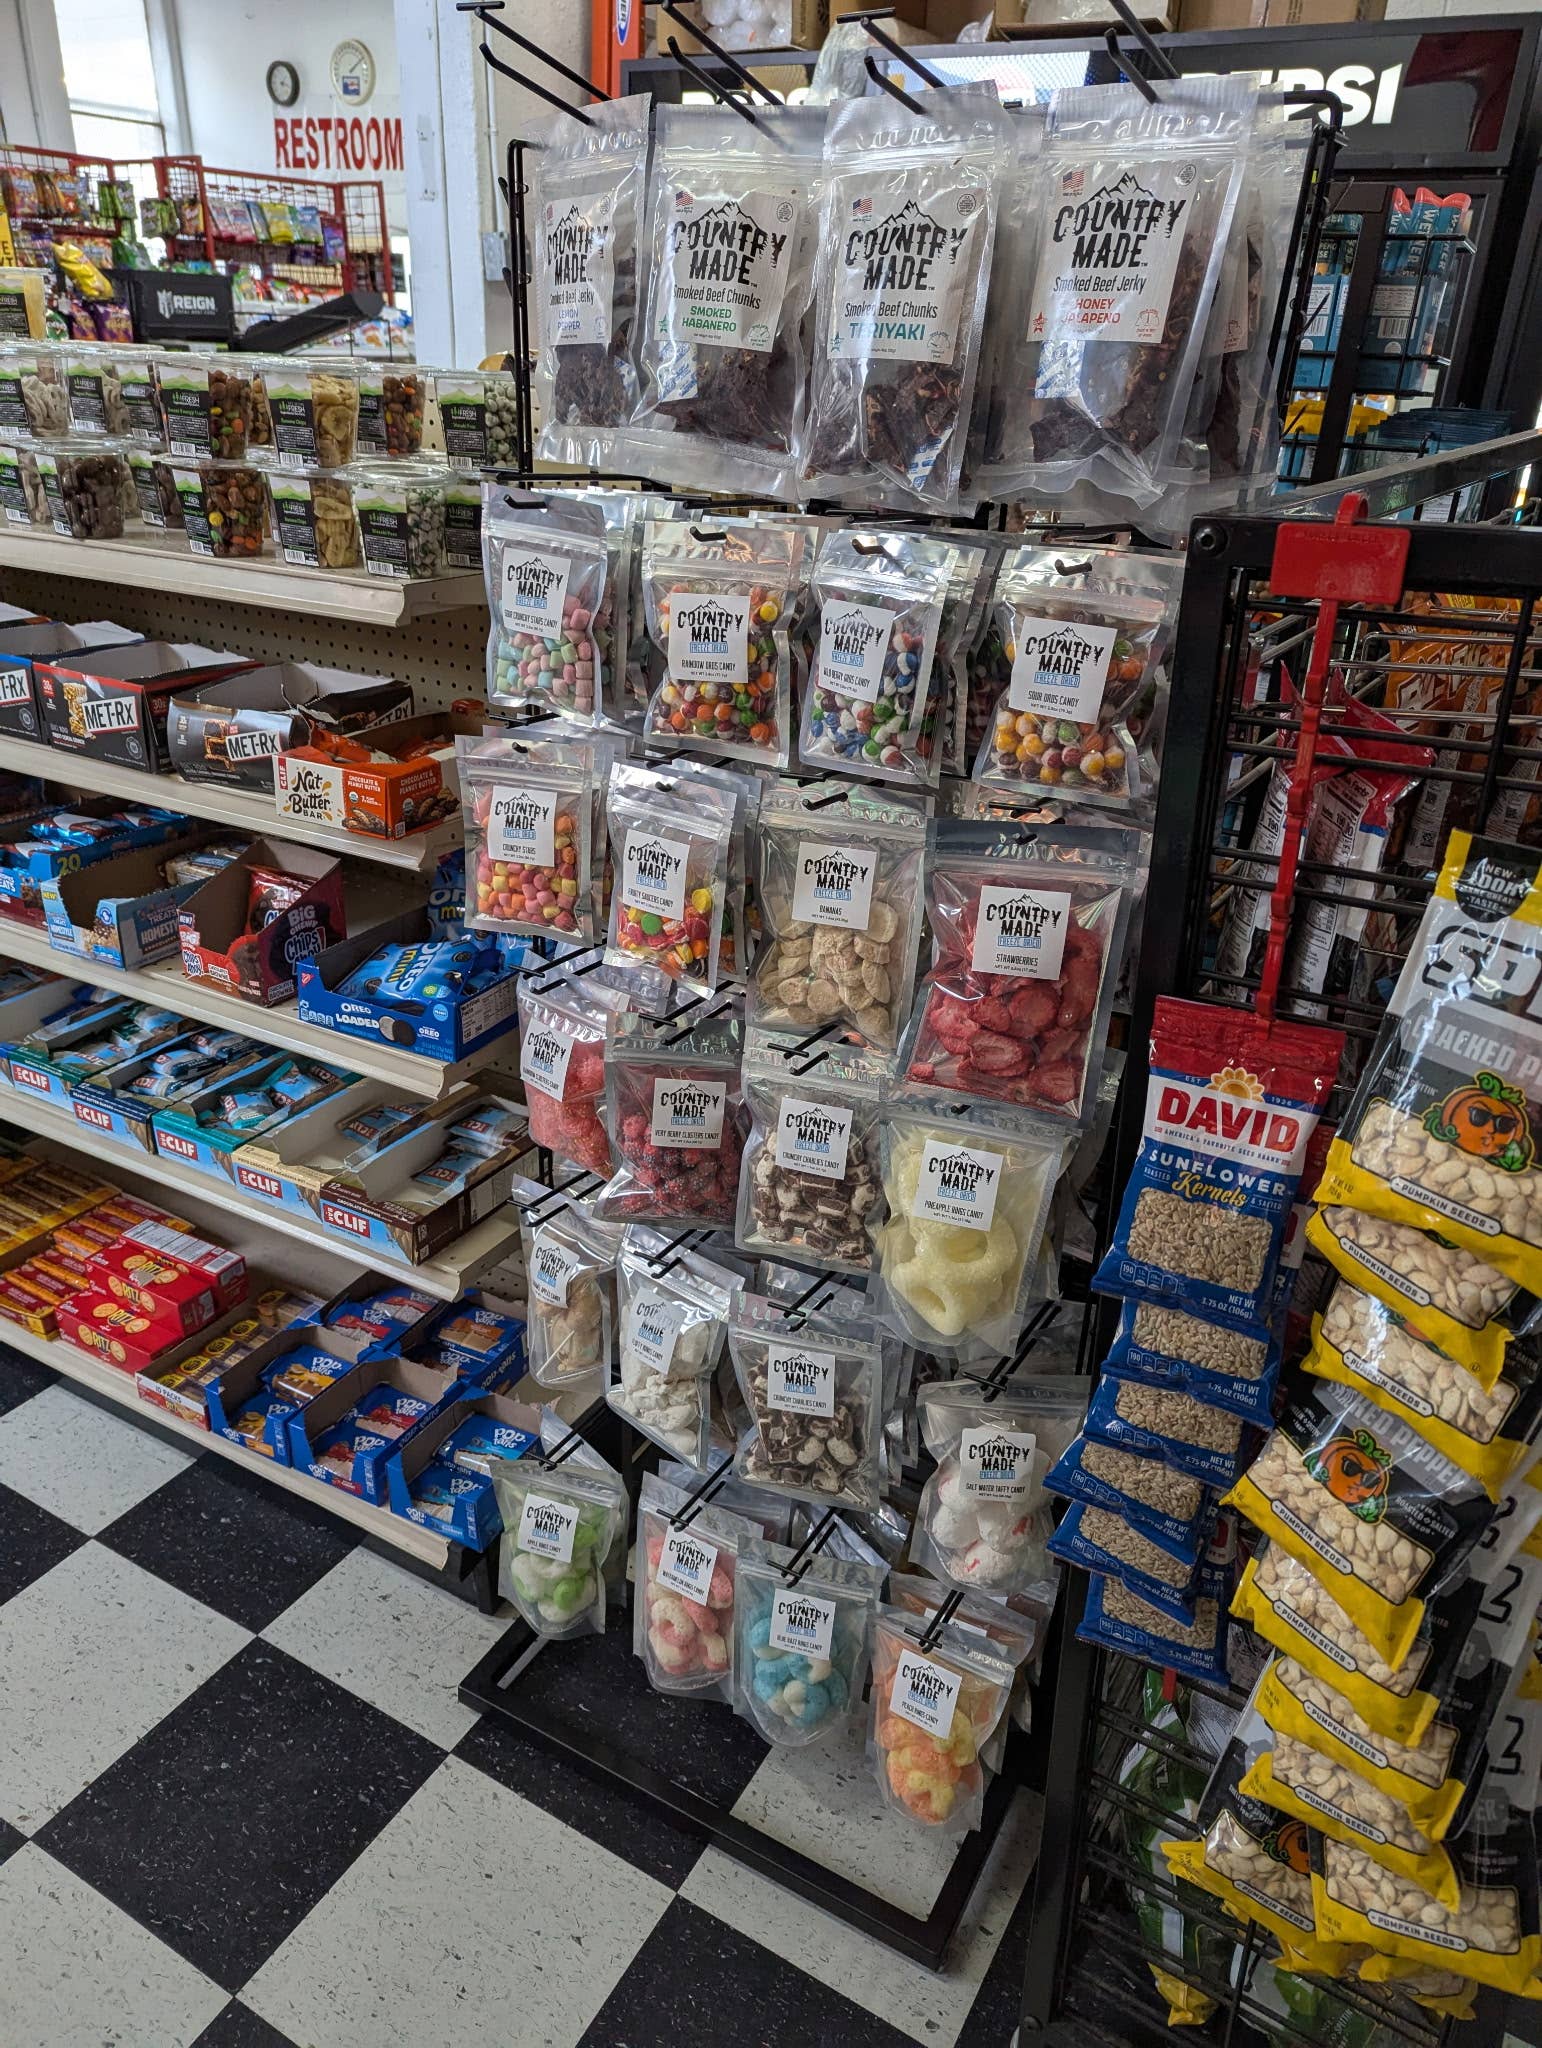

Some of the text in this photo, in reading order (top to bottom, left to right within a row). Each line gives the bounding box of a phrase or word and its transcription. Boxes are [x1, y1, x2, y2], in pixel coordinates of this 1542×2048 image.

[1181, 63, 1403, 127] PSI
[275, 117, 404, 171] RESTROOM
[1053, 200, 1186, 242] COUNTRY
[672, 220, 787, 268] COUNTRY
[845, 223, 968, 265] COUNTRY
[1072, 233, 1146, 268] MADE
[555, 255, 587, 285] MADE
[689, 250, 754, 285] MADE
[864, 255, 932, 290] MADE
[1054, 274, 1146, 294] Smoked Beef Jerky
[174, 295, 215, 310] REIGN
[674, 285, 761, 309] Smoked Beef Chunks
[1075, 299, 1114, 310] HONEY
[559, 308, 578, 318] LEMON
[690, 306, 731, 318] SMOKED
[878, 301, 900, 316] Beef
[902, 302, 938, 318] Chunks
[682, 318, 736, 332] HABANERO
[508, 565, 563, 590] COUNTRY
[518, 581, 549, 600] MADE
[678, 611, 743, 632] COUNTRY
[825, 617, 884, 646] COUNTRY
[692, 626, 727, 643] MADE
[834, 634, 867, 655] MADE
[1025, 637, 1104, 666] COUNTRY
[1039, 655, 1083, 675] MADE
[1028, 691, 1042, 701] SOUR
[1059, 695, 1079, 708] CANDY
[84, 701, 134, 729] MET-Rx
[228, 733, 278, 759] MET-Rx
[293, 771, 322, 792] Nut
[348, 780, 381, 792] PEANUT BUTTER
[349, 776, 373, 785] CHOCOLATE
[289, 792, 330, 814] Butter
[495, 801, 549, 822] COUNTRY
[303, 810, 323, 820] BAR
[505, 815, 536, 830] MADE
[57, 854, 80, 876] 20
[628, 846, 681, 874] COUNTRY
[638, 862, 667, 880] MADE
[805, 859, 868, 883] COUNTRY
[1485, 864, 1512, 879] NEW
[817, 874, 852, 890] MADE
[1479, 874, 1521, 897] OOK
[820, 905, 842, 915] BANANAS
[986, 904, 1061, 928] COUNTRY
[141, 922, 178, 944] HOMESTY
[290, 921, 318, 935] CHEWY
[1001, 920, 1043, 937] MADE
[286, 931, 318, 962] Chips
[399, 943, 444, 992] OREO
[996, 954, 1038, 966] STRAWBERRIES
[341, 1002, 372, 1014] OREO
[336, 1014, 379, 1029] LOADED
[419, 1027, 440, 1038] OREO
[528, 1033, 566, 1060] COUNTRY
[533, 1047, 555, 1065] MADE
[22, 1068, 47, 1088] CLIF
[661, 1092, 719, 1109] COUNTRY
[673, 1105, 706, 1117] MADE
[84, 1107, 109, 1130] CLIF
[786, 1114, 846, 1137] COUNTRY
[1157, 1087, 1299, 1152] DAVID
[798, 1128, 830, 1144] MADE
[167, 1136, 194, 1158] CLIF
[1165, 1130, 1279, 1164] AMERICA'S FAVORITE SEED BRAND
[929, 1157, 995, 1185] COUNTRY
[1144, 1167, 1171, 1181] ROASTED
[1150, 1150, 1286, 1196] SUNFLOWER
[248, 1173, 278, 1193] CLIF
[941, 1173, 977, 1192] MADE
[1172, 1171, 1247, 1207] Kernels
[1258, 1199, 1282, 1210] SALTED
[1401, 1183, 1486, 1228] PUMPKIN SEEDS
[334, 1211, 366, 1232] CLIF
[536, 1247, 571, 1276] COUNTRY
[540, 1262, 559, 1280] MADE
[1123, 1264, 1133, 1274] 190
[1348, 1244, 1418, 1298] PUMPKIN SEEDS
[1229, 1295, 1256, 1310] NET WT
[92, 1331, 110, 1350] RITZ
[774, 1360, 828, 1380] COUNTRY
[786, 1373, 816, 1386] MADE
[1233, 1382, 1260, 1395] NET WT
[1350, 1358, 1421, 1408] PUMPKIN SEEDS
[969, 1445, 1030, 1462] COUNTRY
[1210, 1456, 1236, 1469] NET WT
[982, 1458, 1015, 1471] MADE
[979, 1484, 994, 1492] WATER
[527, 1506, 572, 1530] COUNTRY
[535, 1519, 560, 1534] MADE
[1165, 1520, 1190, 1535] NET WT
[1279, 1506, 1342, 1567] PUMPKIN SEEDS
[669, 1540, 711, 1568] COUNTRY
[677, 1554, 700, 1571] MADE
[779, 1602, 829, 1624] COUNTRY
[788, 1615, 817, 1629] MADE
[1281, 1607, 1347, 1665] PUMPKIN SEEDS
[902, 1665, 953, 1700] COUNTRY
[911, 1681, 939, 1702] MADE
[1311, 1708, 1378, 1761] PUMPKIN SEEDS
[1303, 1791, 1377, 1839] PUMPKIN SEEDS
[1241, 1882, 1306, 1927] PUMPKIN SEEDS
[1377, 1914, 1456, 1948] PUMPKIN SEEDS
